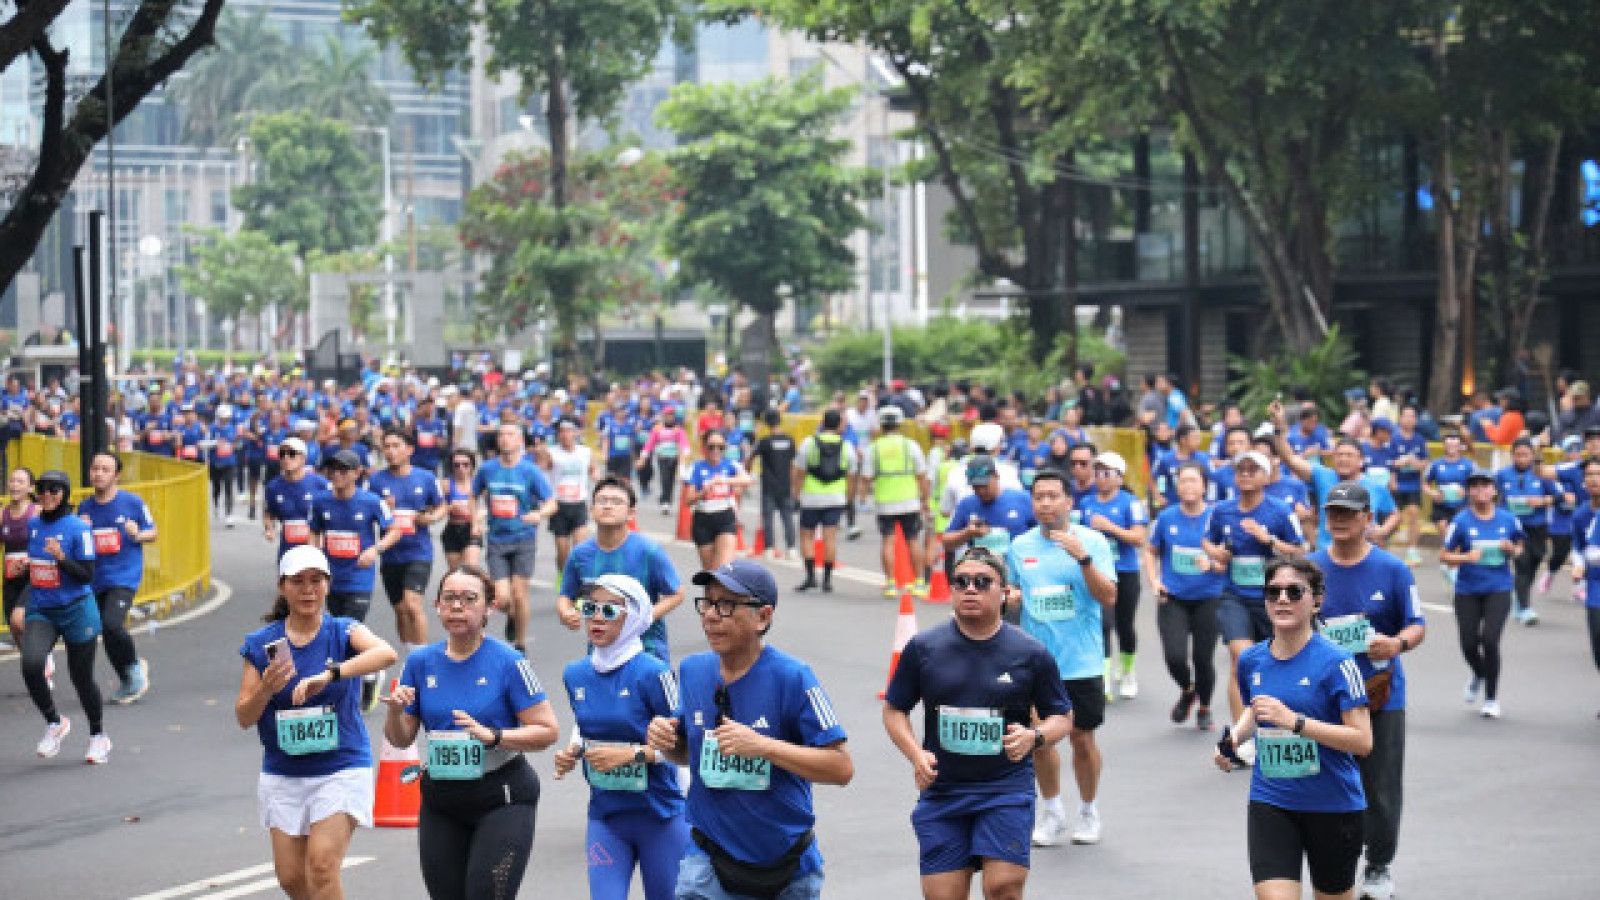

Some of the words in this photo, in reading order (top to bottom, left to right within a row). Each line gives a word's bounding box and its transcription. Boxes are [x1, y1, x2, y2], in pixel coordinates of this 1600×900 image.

[290, 720, 333, 743] 18427
[952, 721, 1001, 742] 16790
[435, 744, 481, 766] 19519
[1266, 742, 1316, 766] 17434
